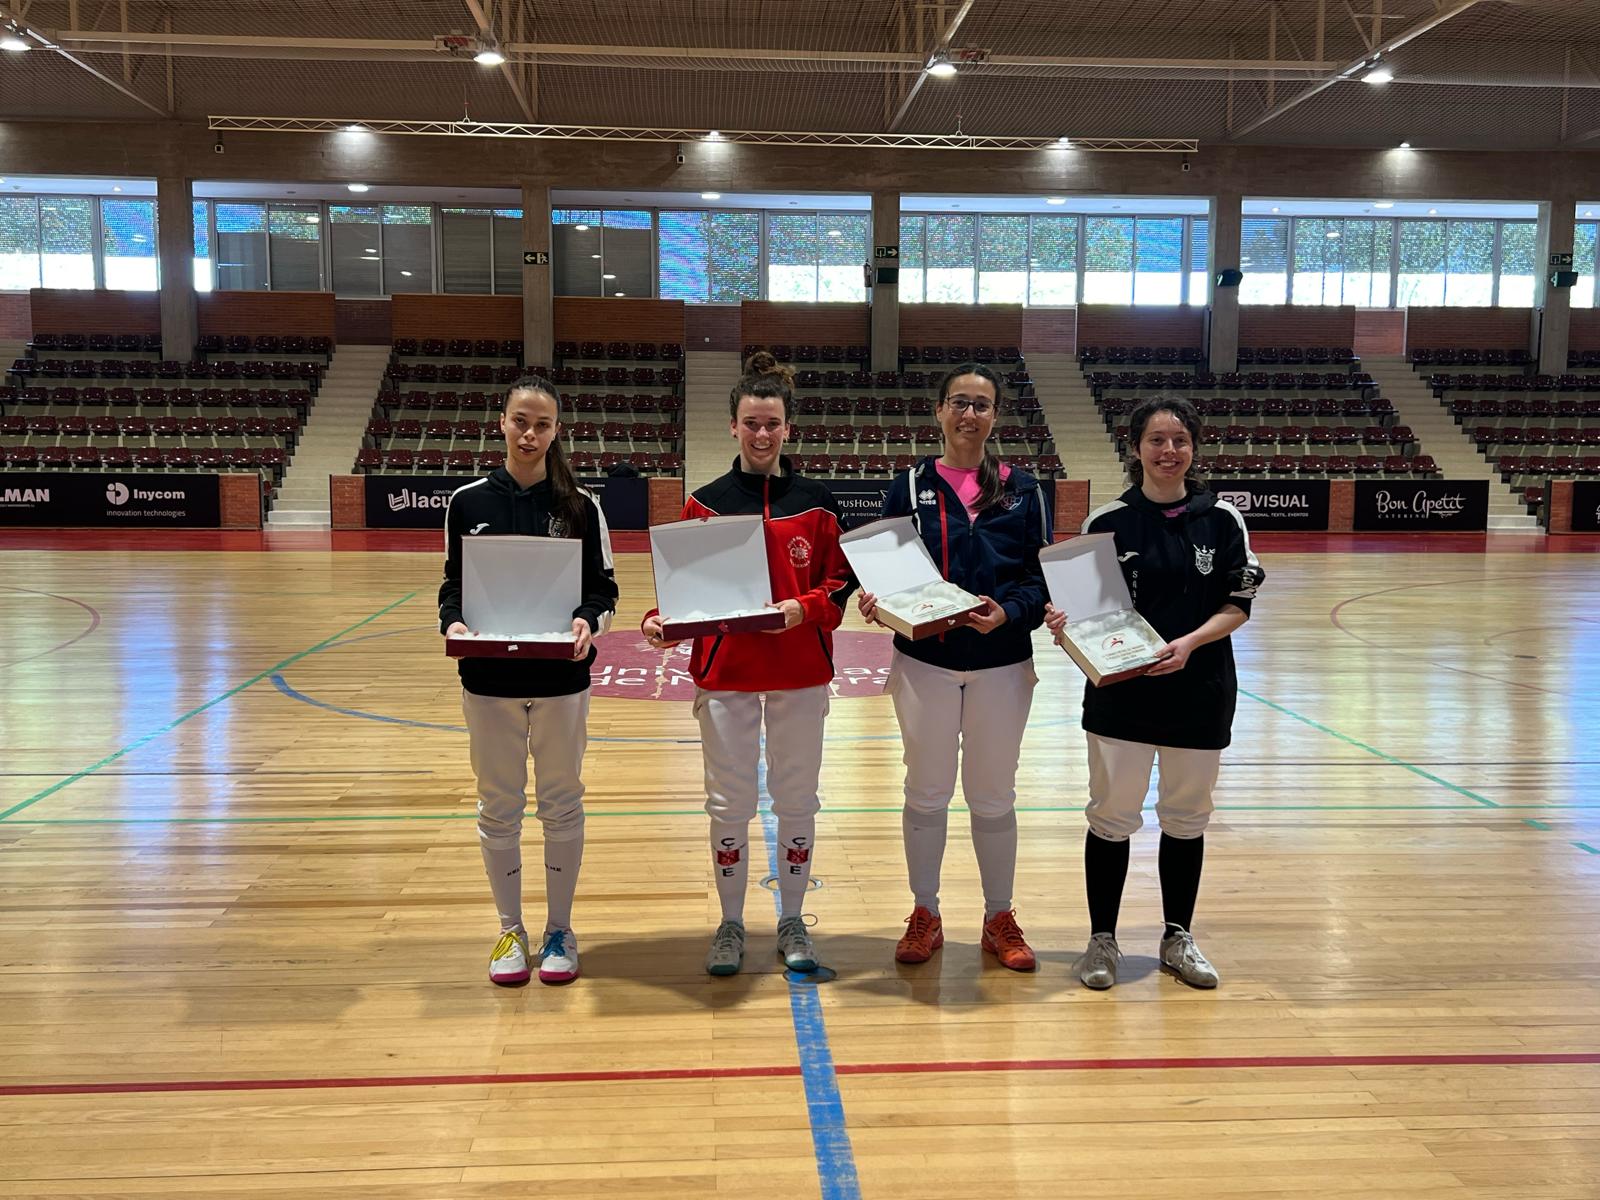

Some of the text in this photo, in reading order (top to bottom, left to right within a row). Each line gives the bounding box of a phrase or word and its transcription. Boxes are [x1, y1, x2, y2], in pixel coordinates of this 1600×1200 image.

[133, 489, 186, 501] Inycom
[411, 492, 451, 508] lacu
[1252, 494, 1309, 508] VISUAL
[1375, 490, 1467, 519] Bon Apetit
[106, 509, 187, 518] innovation technologies
